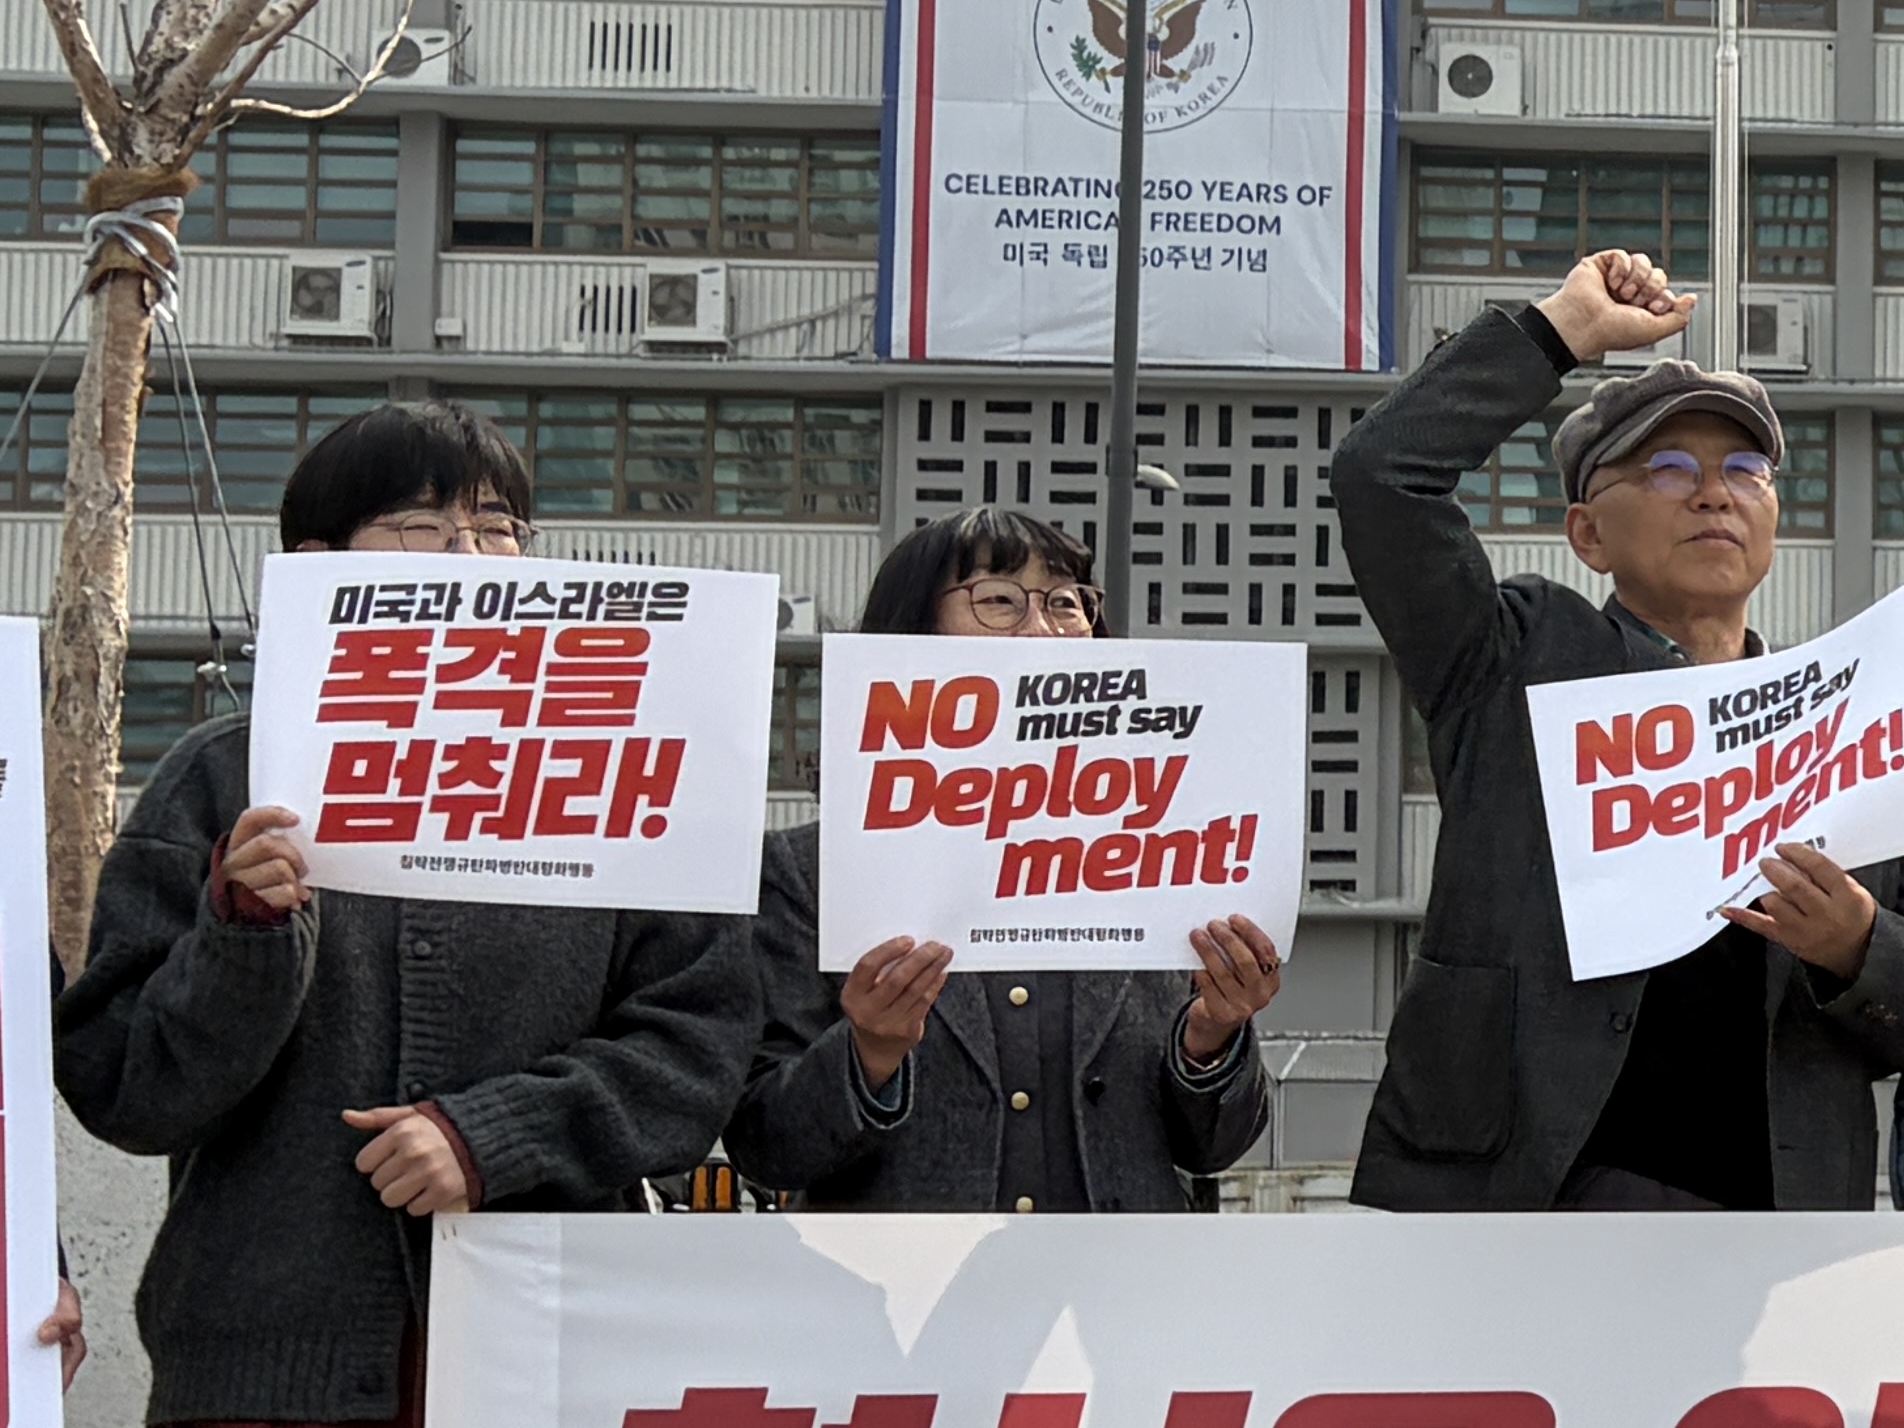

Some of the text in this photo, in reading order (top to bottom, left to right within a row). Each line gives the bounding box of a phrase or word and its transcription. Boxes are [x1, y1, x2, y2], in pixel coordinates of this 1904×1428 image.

[1175, 75, 1229, 119] KOREA
[995, 208, 1282, 235] AMERICA FREEDOM
[1143, 179, 1192, 201] 250
[1201, 180, 1288, 204] YEARS
[1297, 185, 1333, 207] OF
[1002, 242, 1049, 267] 미국
[1062, 243, 1108, 268] 독립
[1221, 247, 1268, 272] 기념
[329, 581, 689, 625] 미국과 이스라엘은
[316, 626, 651, 729] 폭격을
[859, 676, 999, 753] NO
[1015, 669, 1147, 708] KOREA
[1709, 660, 1822, 726] KOREA
[1716, 658, 1860, 754] must say
[1016, 704, 1203, 742] must say
[1575, 704, 1694, 785] NO
[315, 737, 686, 843] 멈춰라!
[863, 745, 1189, 840] Deploy
[1592, 696, 1850, 853] Deploy
[1722, 708, 1904, 880] ment!
[995, 814, 1258, 899] ment!
